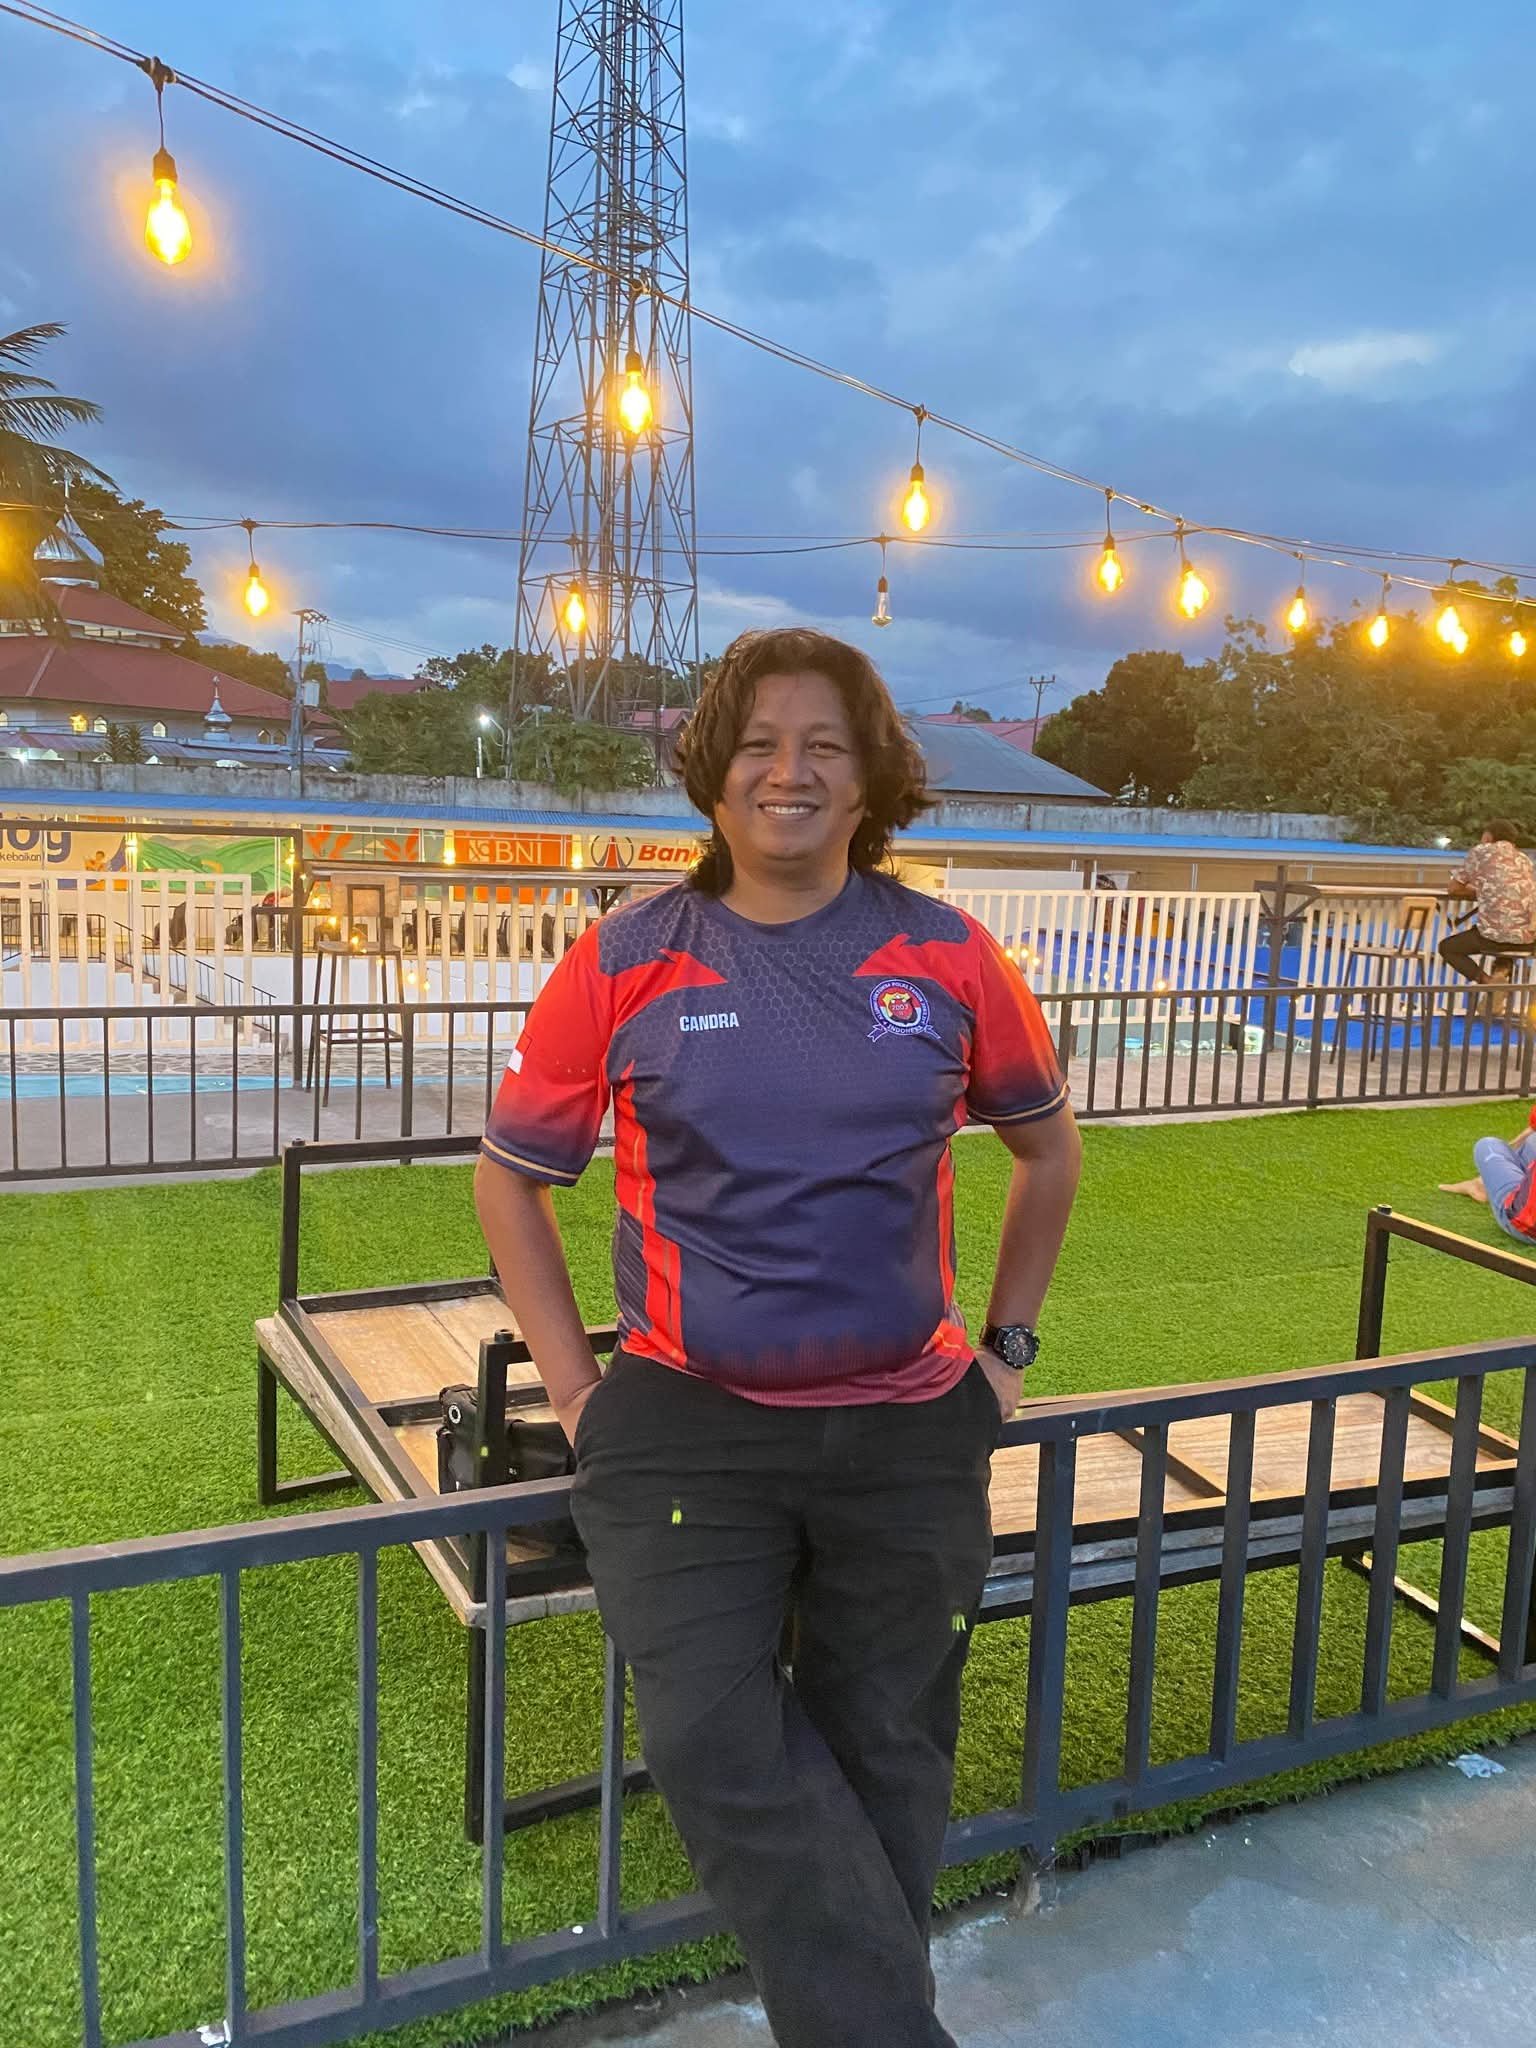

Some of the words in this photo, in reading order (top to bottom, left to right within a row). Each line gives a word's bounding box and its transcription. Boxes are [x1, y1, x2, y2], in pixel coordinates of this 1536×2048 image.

[0, 810, 71, 863] og
[496, 840, 542, 864] BNI
[680, 1012, 739, 1031] CANDRA
